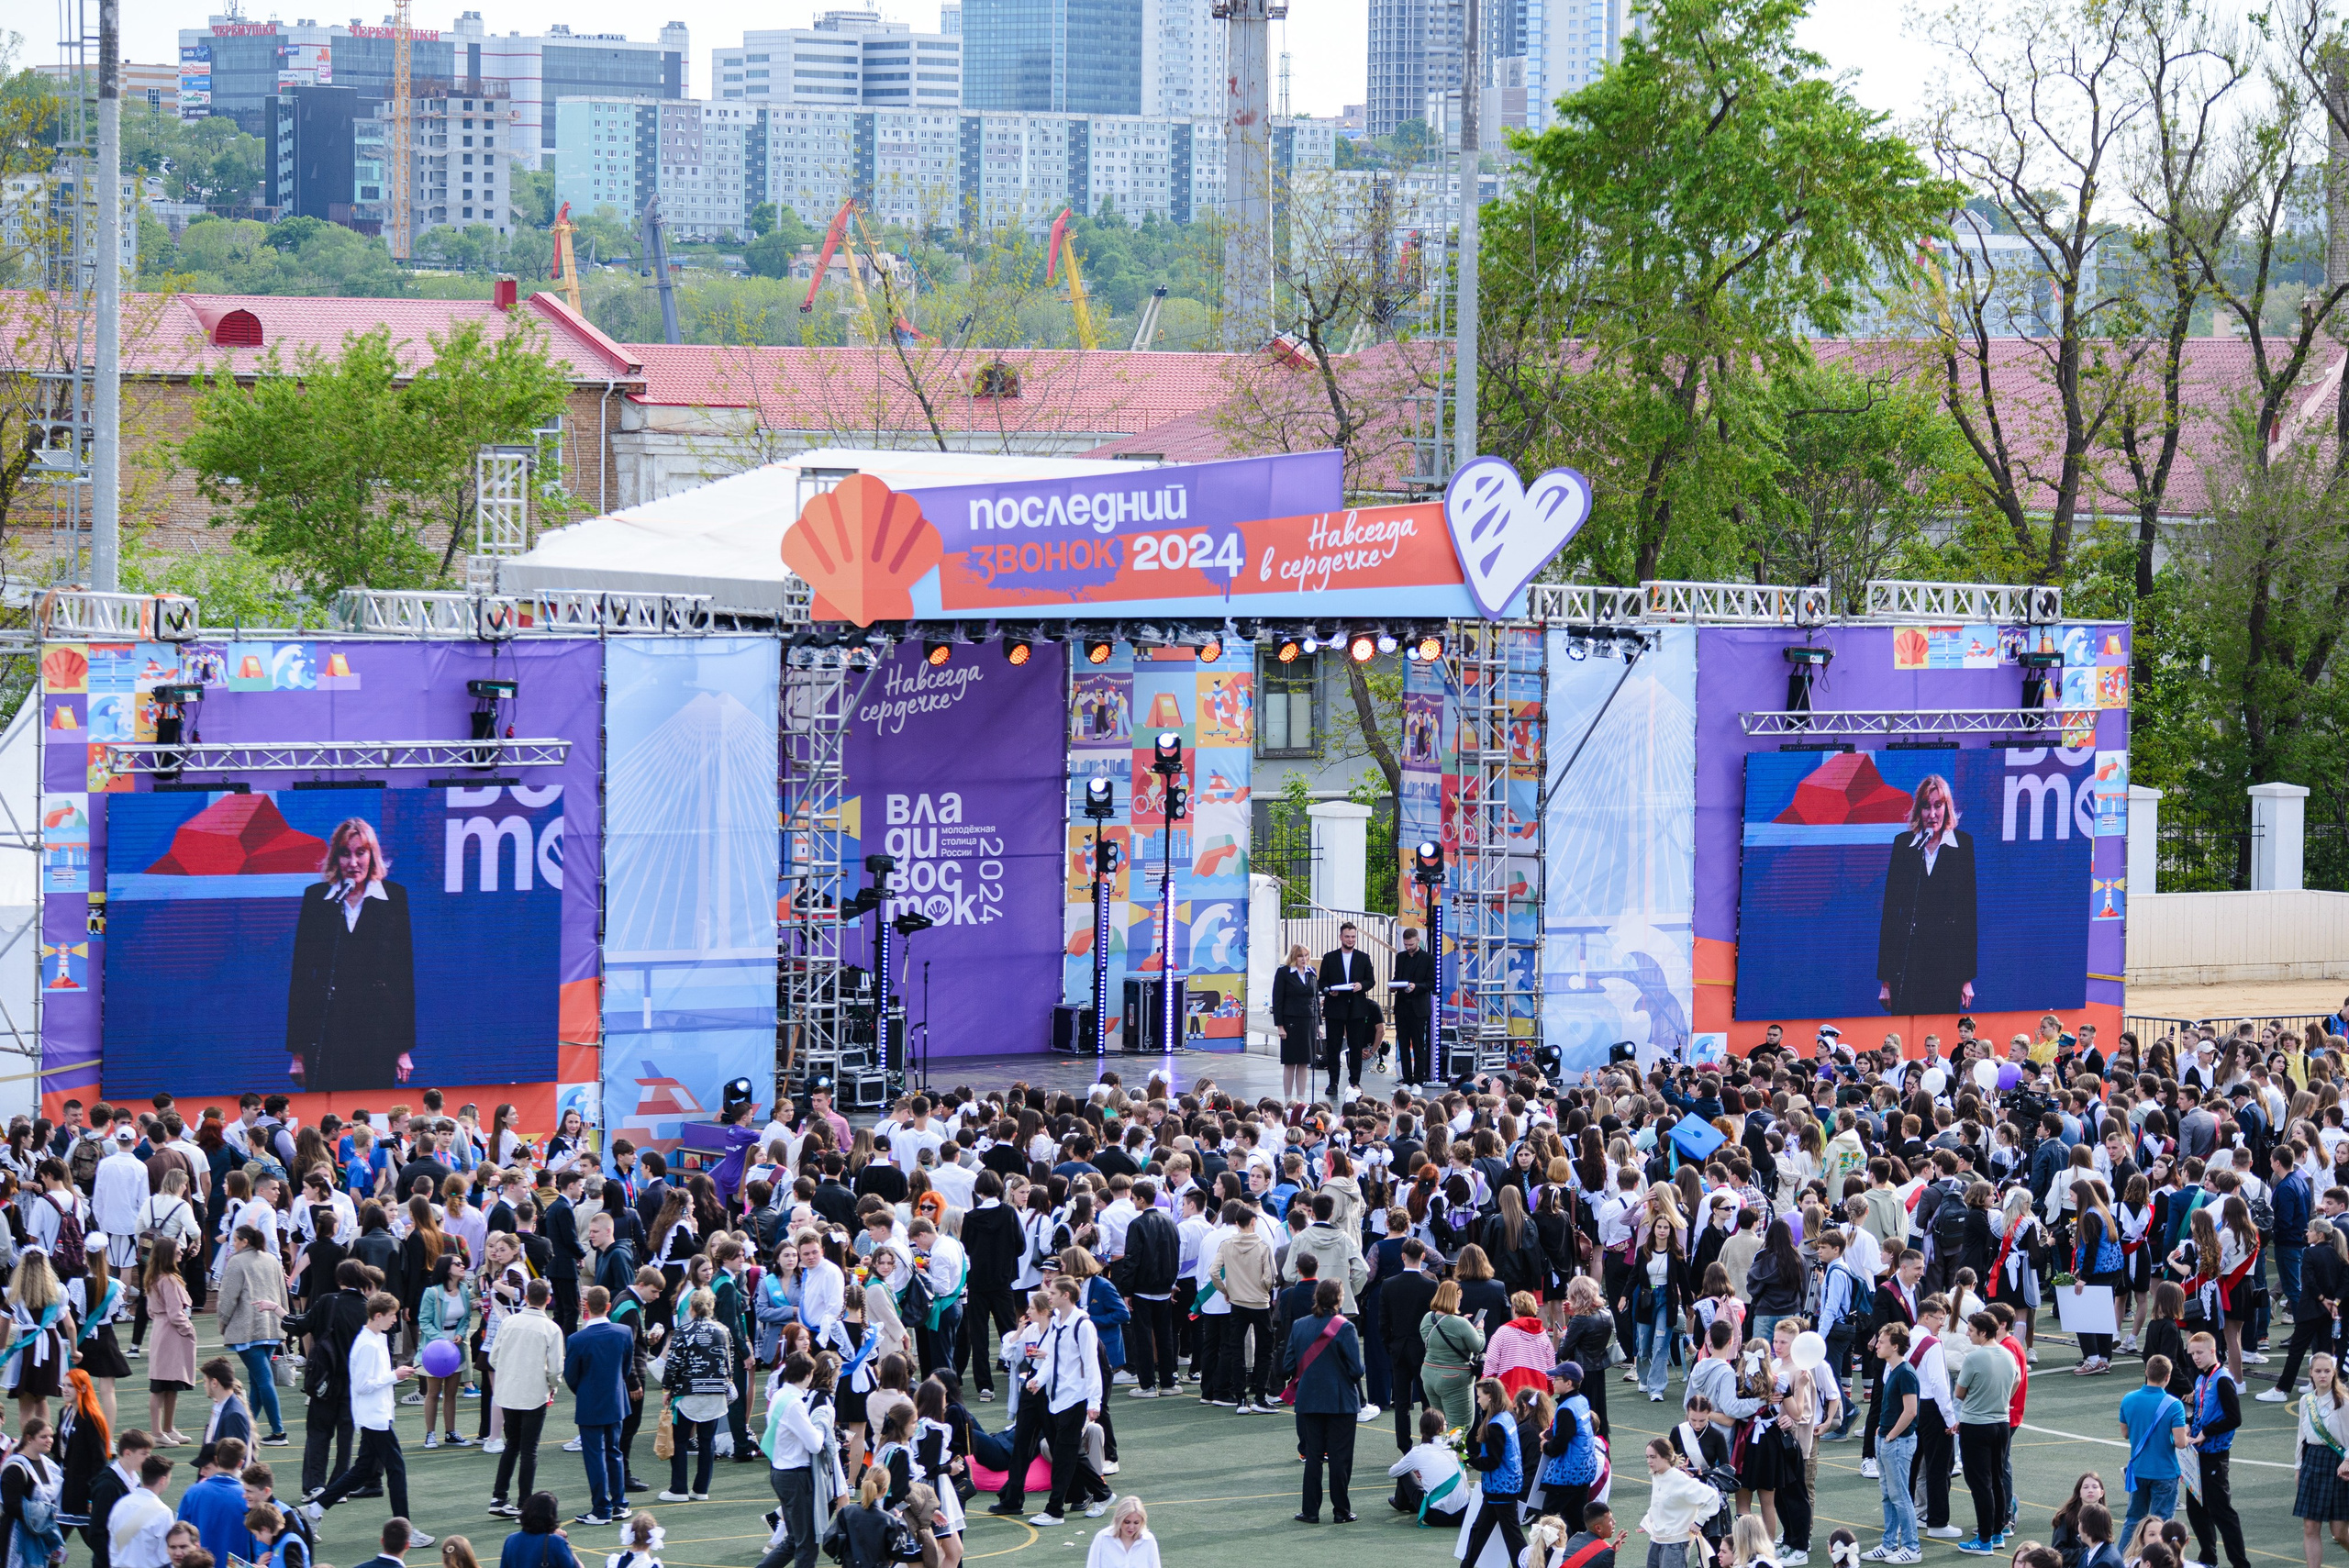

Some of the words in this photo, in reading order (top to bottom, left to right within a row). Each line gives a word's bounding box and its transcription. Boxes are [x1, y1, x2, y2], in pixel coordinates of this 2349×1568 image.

[211, 23, 277, 37] ЧЕРЕМУШКИ
[348, 26, 440, 42] ЧЕРЕМШКИ
[969, 484, 1187, 533] последний
[1133, 532, 1244, 578] 2024
[1308, 510, 1419, 559] Навсегда
[1260, 546, 1275, 583] в
[1280, 549, 1383, 595] сердечке
[885, 660, 985, 701] Навсегда
[860, 693, 952, 736] сердечке
[941, 824, 996, 835] молодёжная
[941, 837, 977, 846] столица
[941, 848, 973, 858] России
[978, 837, 1005, 925] 2024
